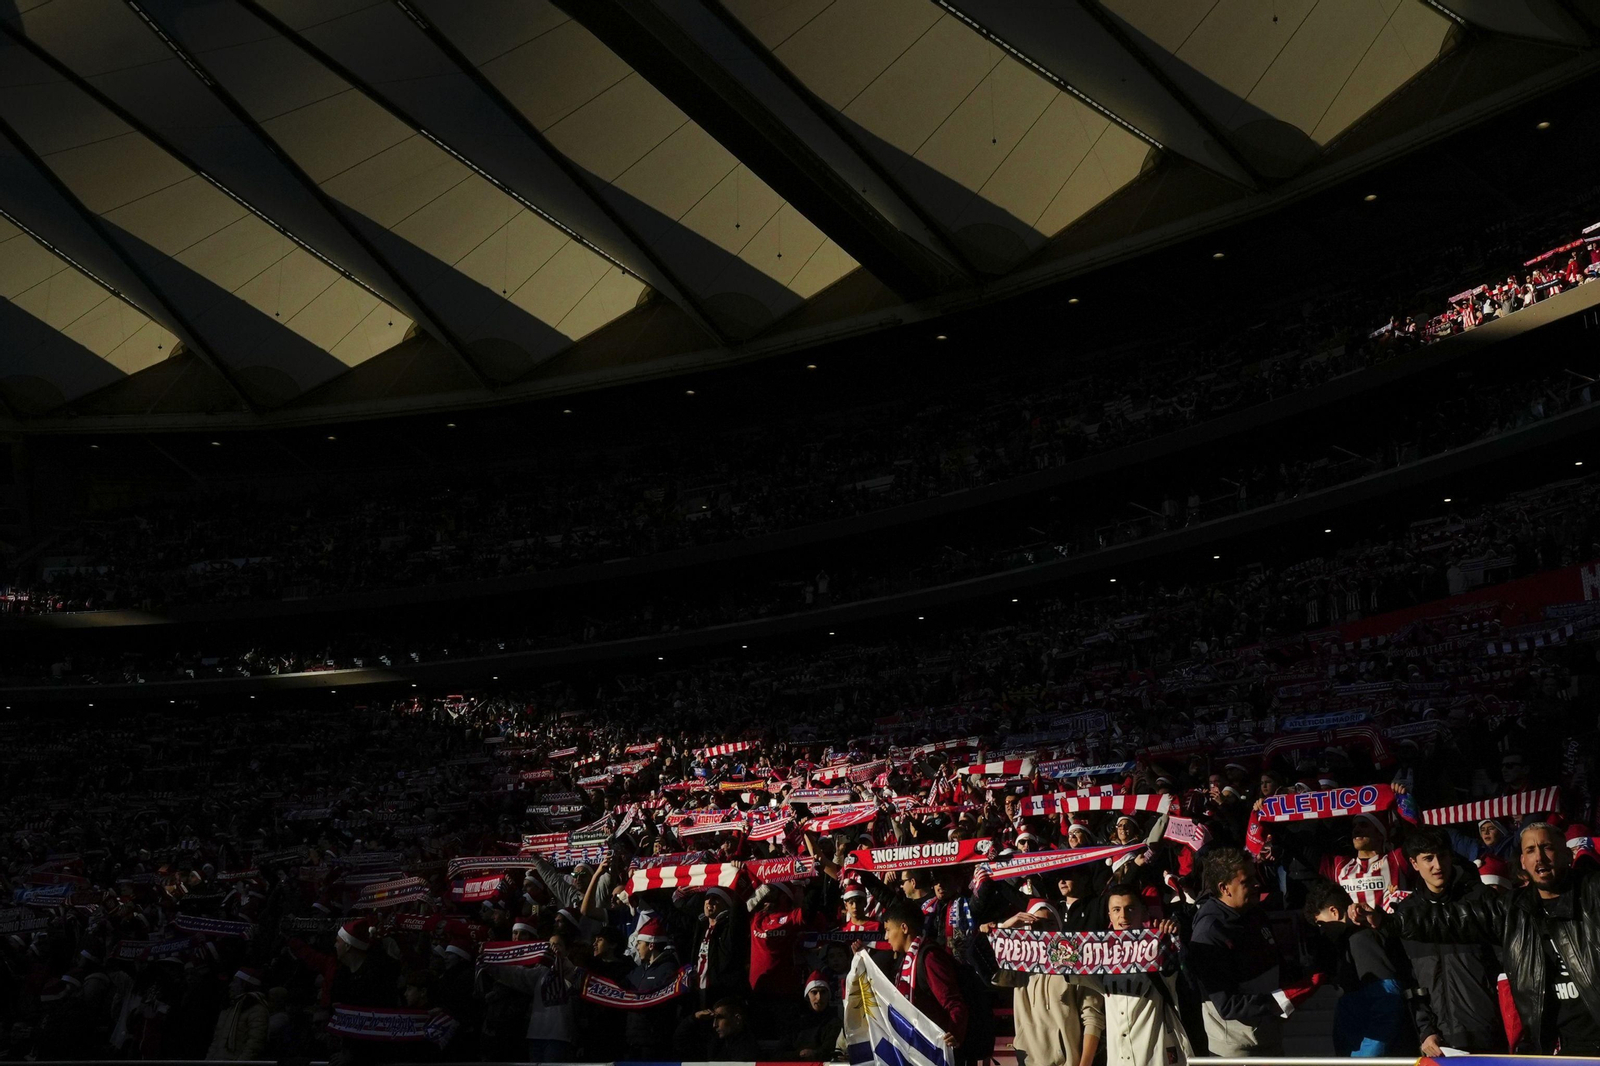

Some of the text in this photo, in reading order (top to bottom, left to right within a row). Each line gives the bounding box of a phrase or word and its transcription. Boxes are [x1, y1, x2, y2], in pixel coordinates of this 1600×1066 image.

[1025, 798, 1060, 810] ATLETIC
[871, 841, 959, 865] CHOLO SIMEONE
[1342, 881, 1384, 893] Plus500
[995, 938, 1049, 966] FRENTE
